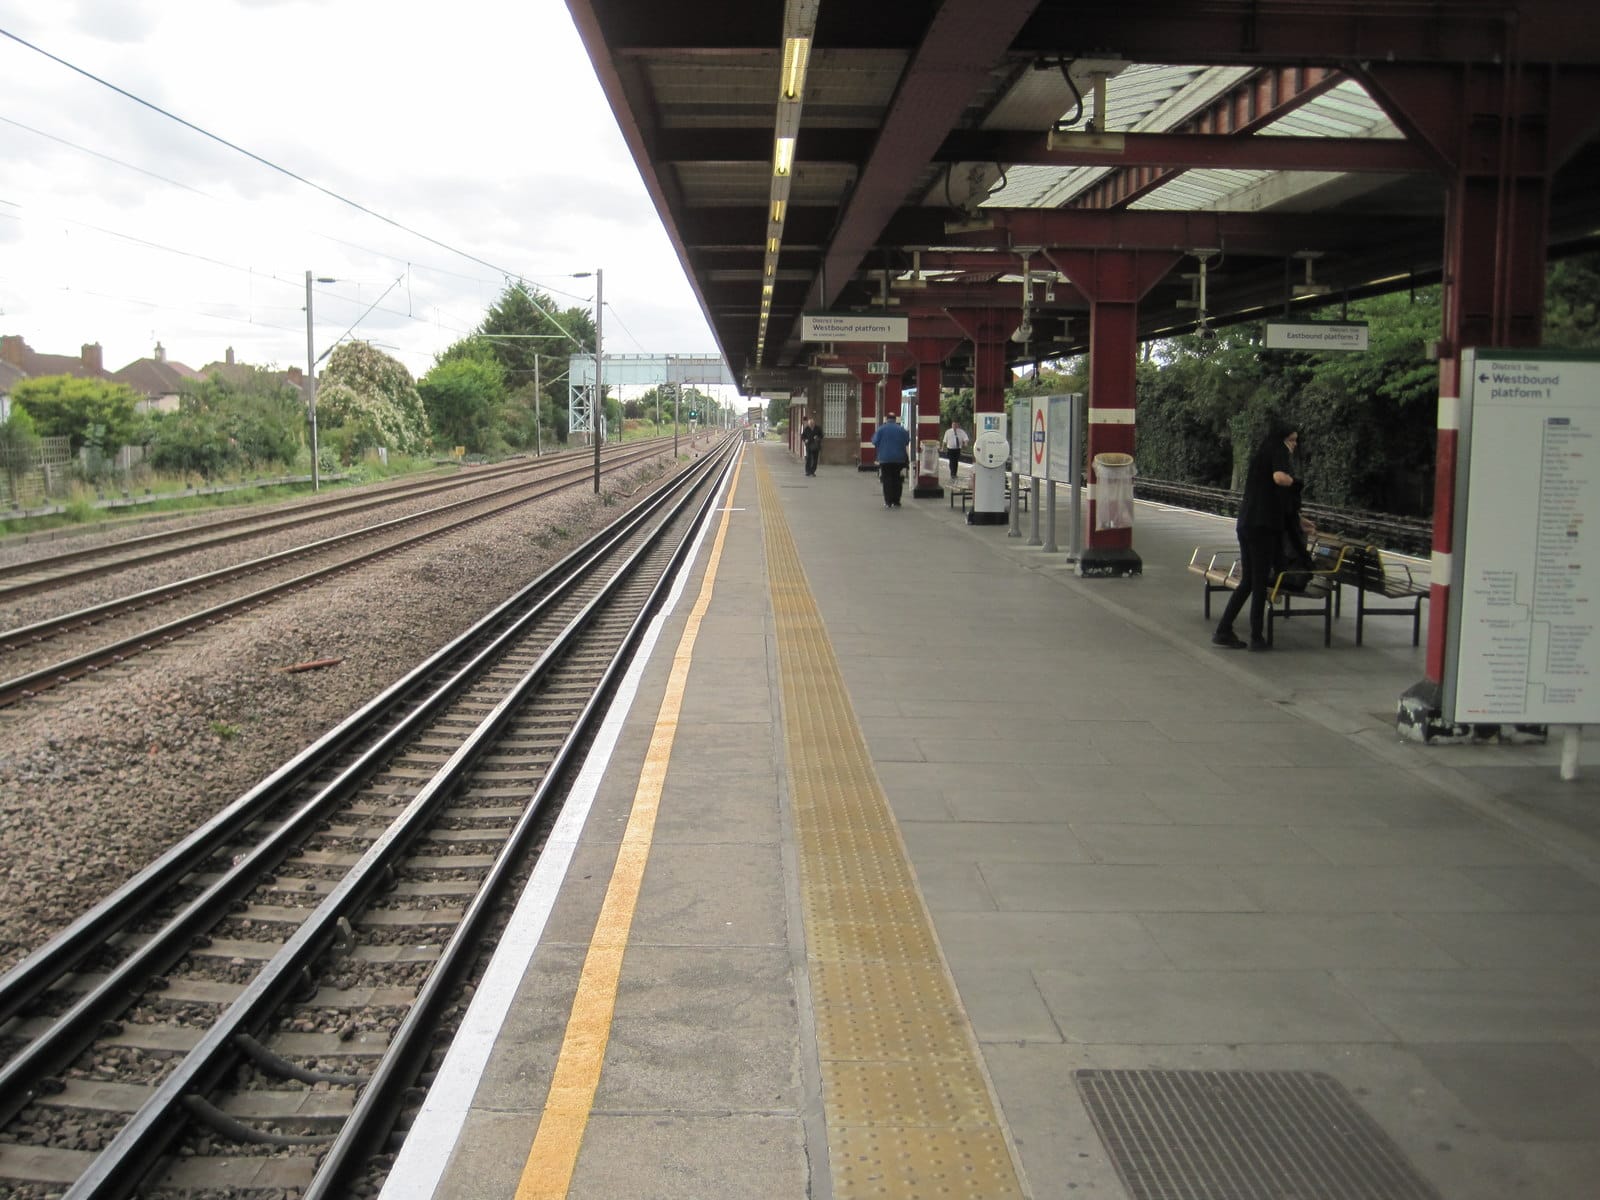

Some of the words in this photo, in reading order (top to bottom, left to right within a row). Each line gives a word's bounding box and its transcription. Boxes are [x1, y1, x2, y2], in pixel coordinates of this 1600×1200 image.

[813, 324, 853, 332] Westbound
[1491, 363, 1521, 371] District
[1524, 363, 1539, 371] line
[1492, 373, 1560, 385] Westbound
[1491, 387, 1542, 399] platform
[1546, 388, 1551, 398] 1
